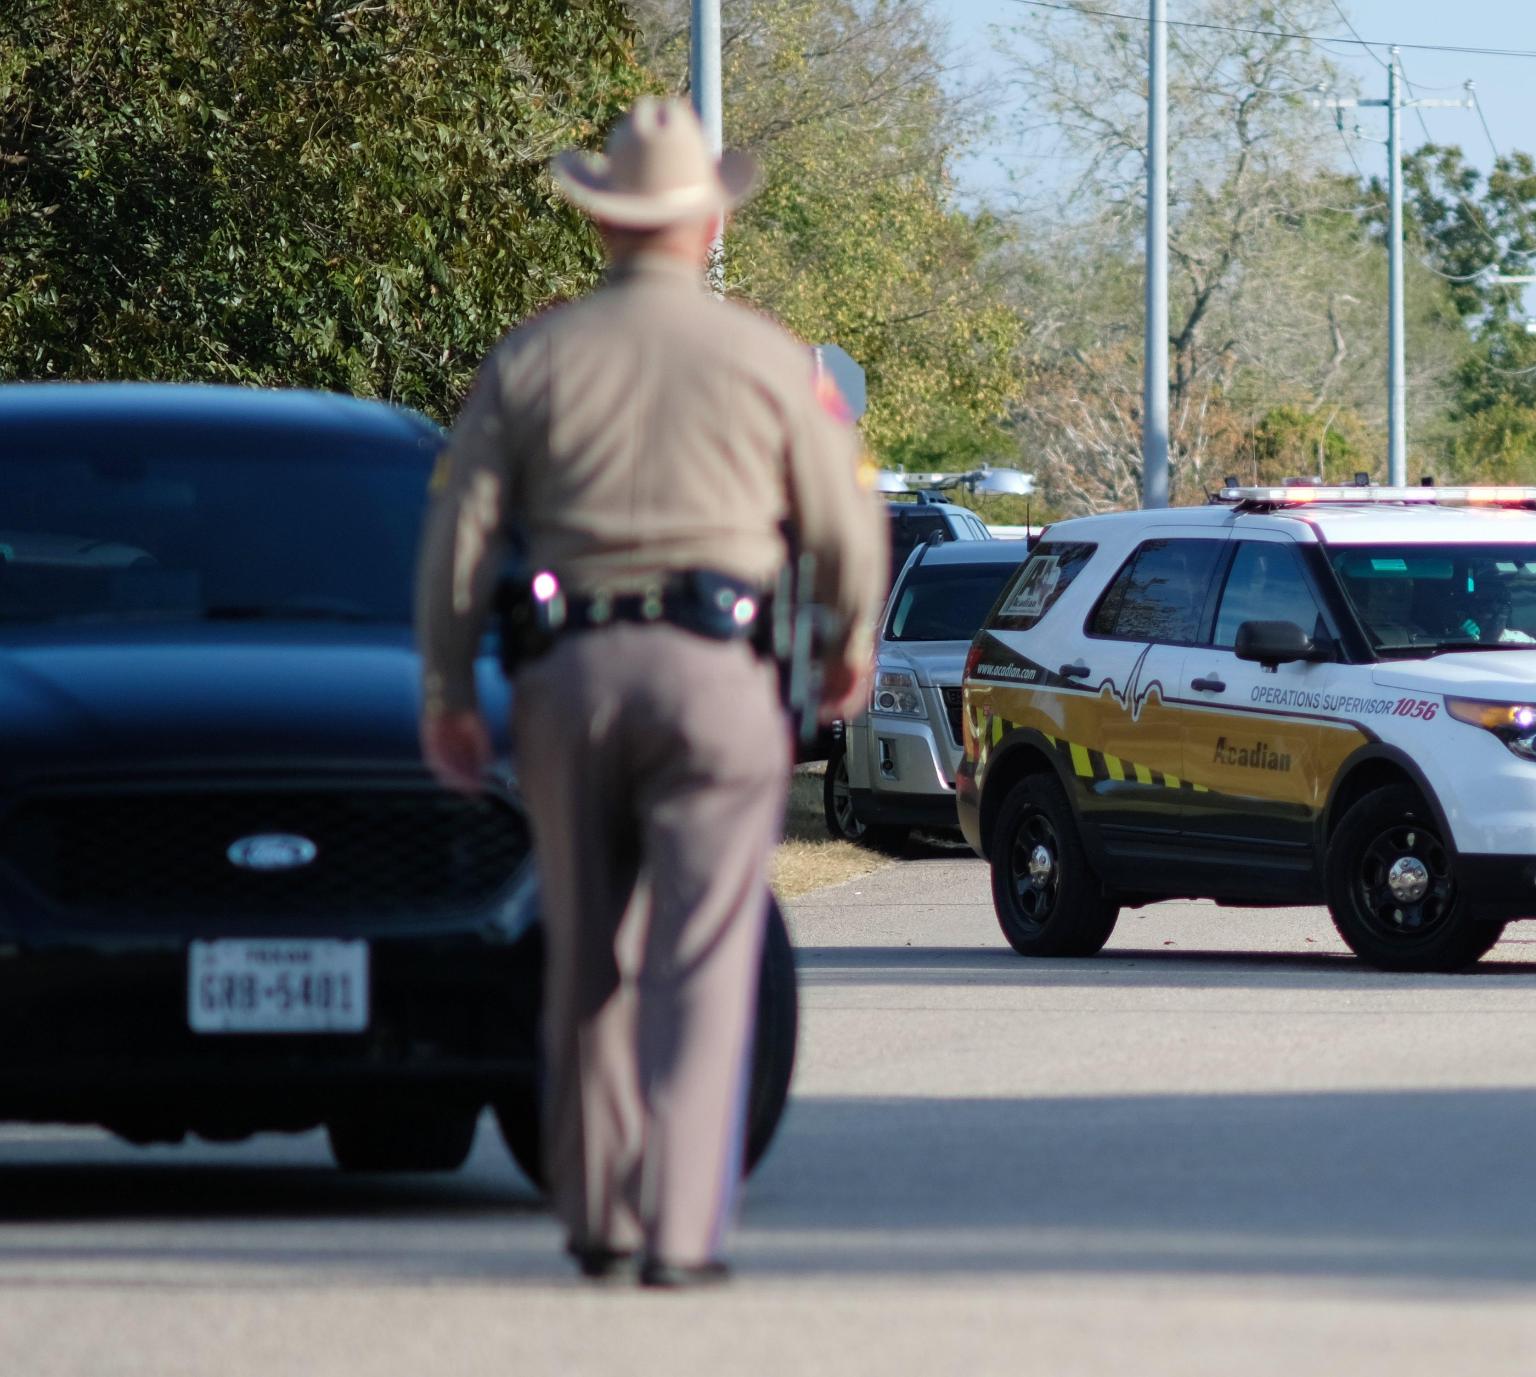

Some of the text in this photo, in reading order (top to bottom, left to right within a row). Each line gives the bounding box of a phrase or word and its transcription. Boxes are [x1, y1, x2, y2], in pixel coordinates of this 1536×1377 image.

[977, 663, 1037, 680] www.acadian.com
[1251, 685, 1440, 721] OPERATIONS SUPERVISOR 1056
[1214, 736, 1292, 772] Acadian
